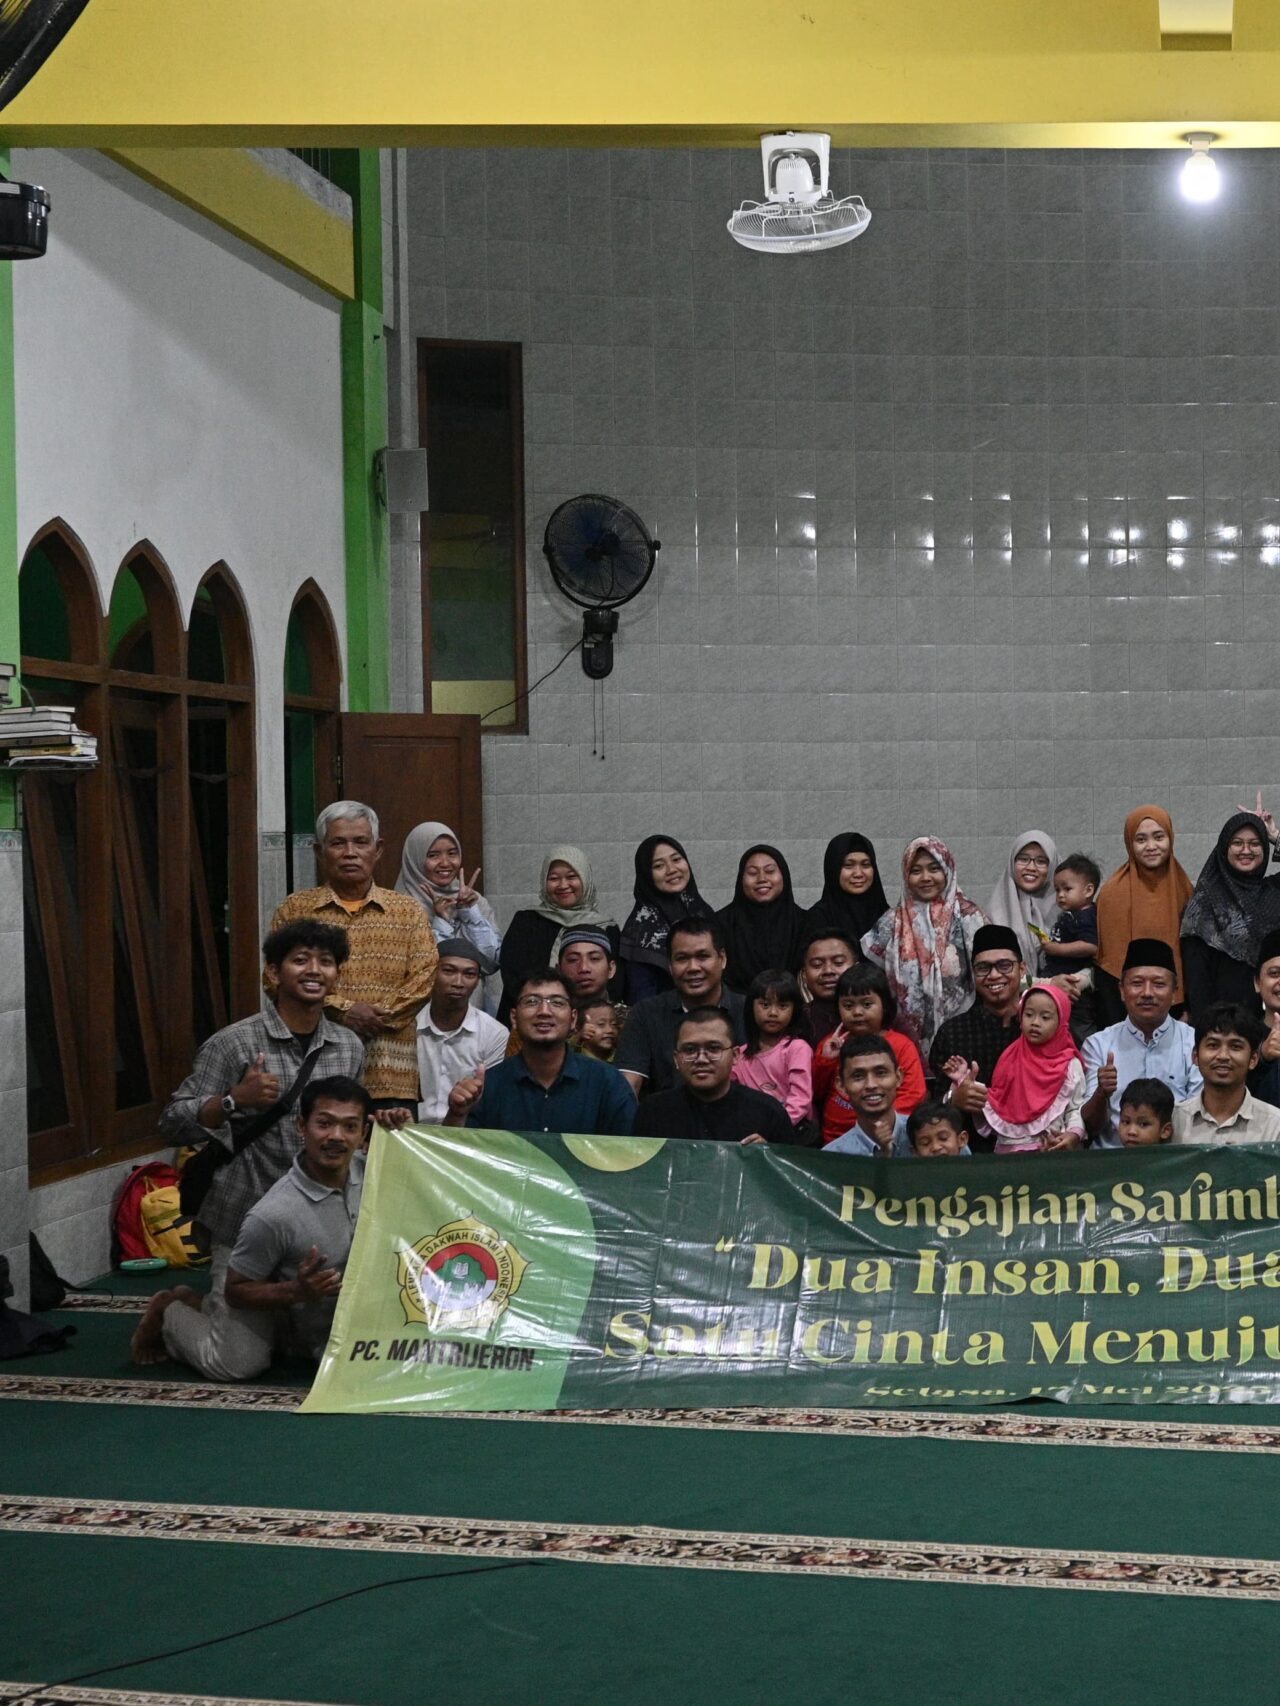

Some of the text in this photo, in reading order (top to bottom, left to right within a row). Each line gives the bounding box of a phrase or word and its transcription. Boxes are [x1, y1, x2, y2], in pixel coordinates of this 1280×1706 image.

[840, 1184, 1097, 1238] Pengajian
[427, 1232, 469, 1254] DAKWAH
[470, 1233, 499, 1252] ISLAM
[913, 1249, 1140, 1296] Insan,
[350, 1339, 536, 1371] PC. MANTRIJERON
[802, 1317, 1007, 1366] Cinta
